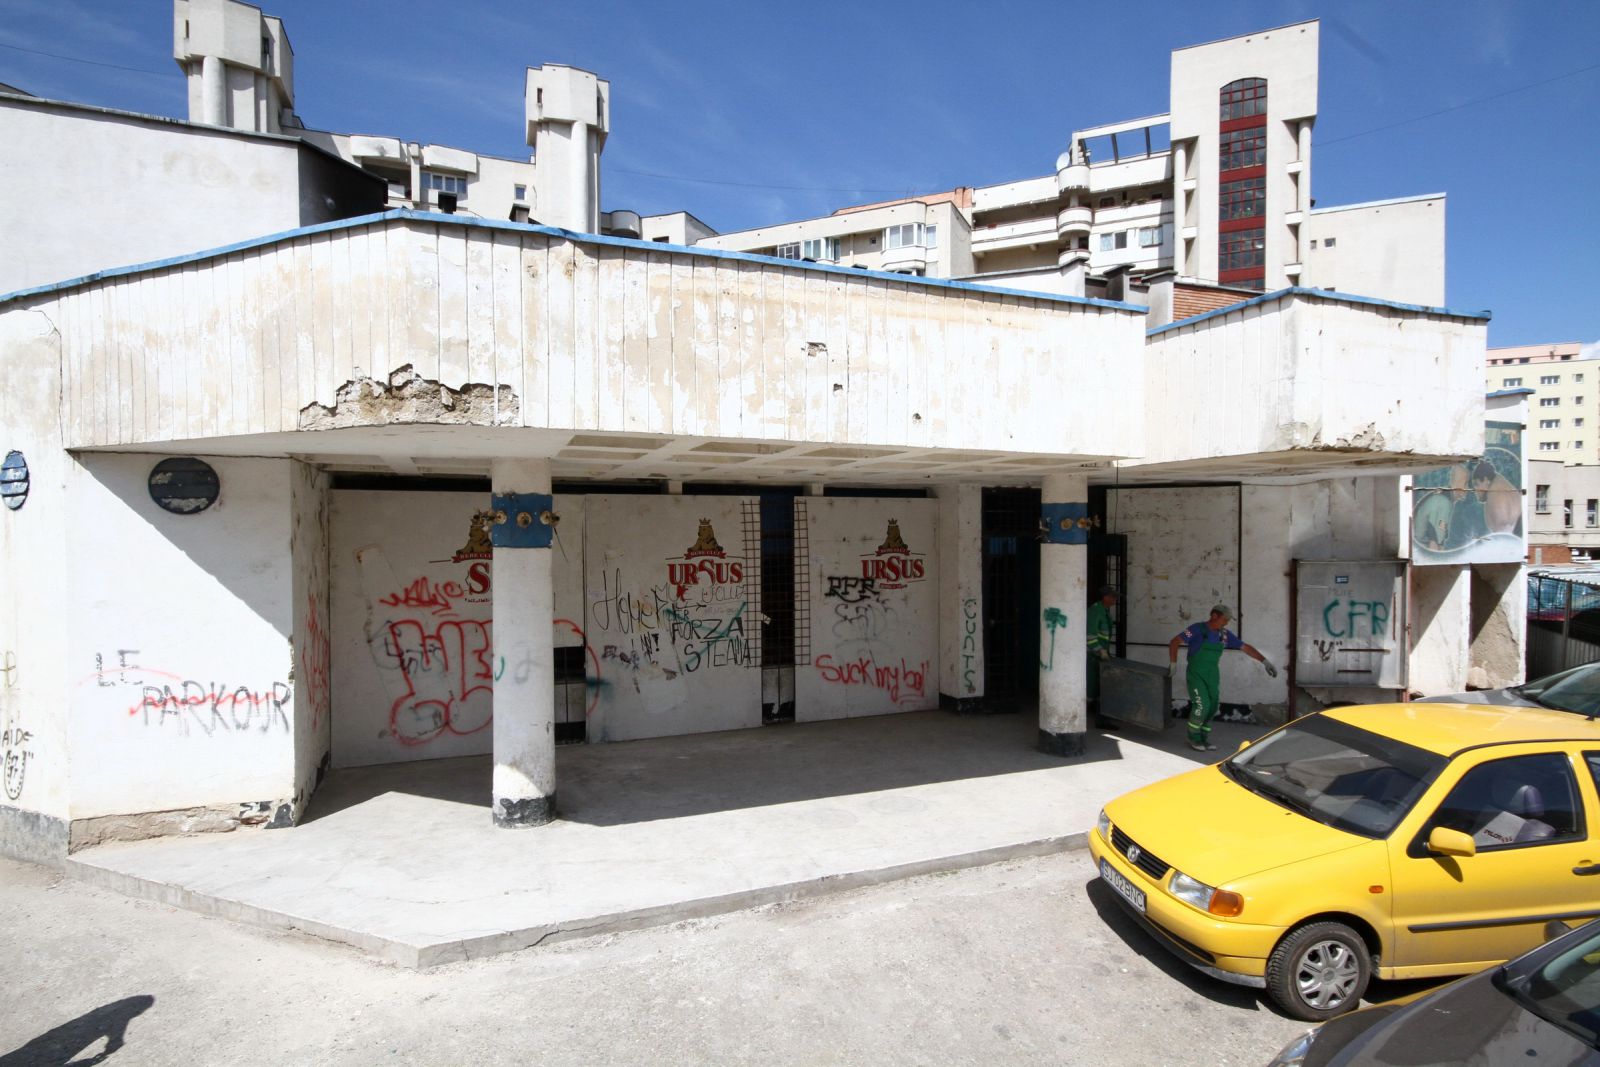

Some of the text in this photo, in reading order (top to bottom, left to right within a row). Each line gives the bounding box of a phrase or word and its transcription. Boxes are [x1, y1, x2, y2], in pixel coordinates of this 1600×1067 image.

[667, 558, 743, 586] URSUS
[861, 556, 925, 582] URSUS
[671, 616, 745, 645] FORZA
[1322, 598, 1389, 638] CFR
[95, 649, 144, 687] LE
[815, 654, 871, 686] Suck
[142, 680, 292, 737] PARKOUR
